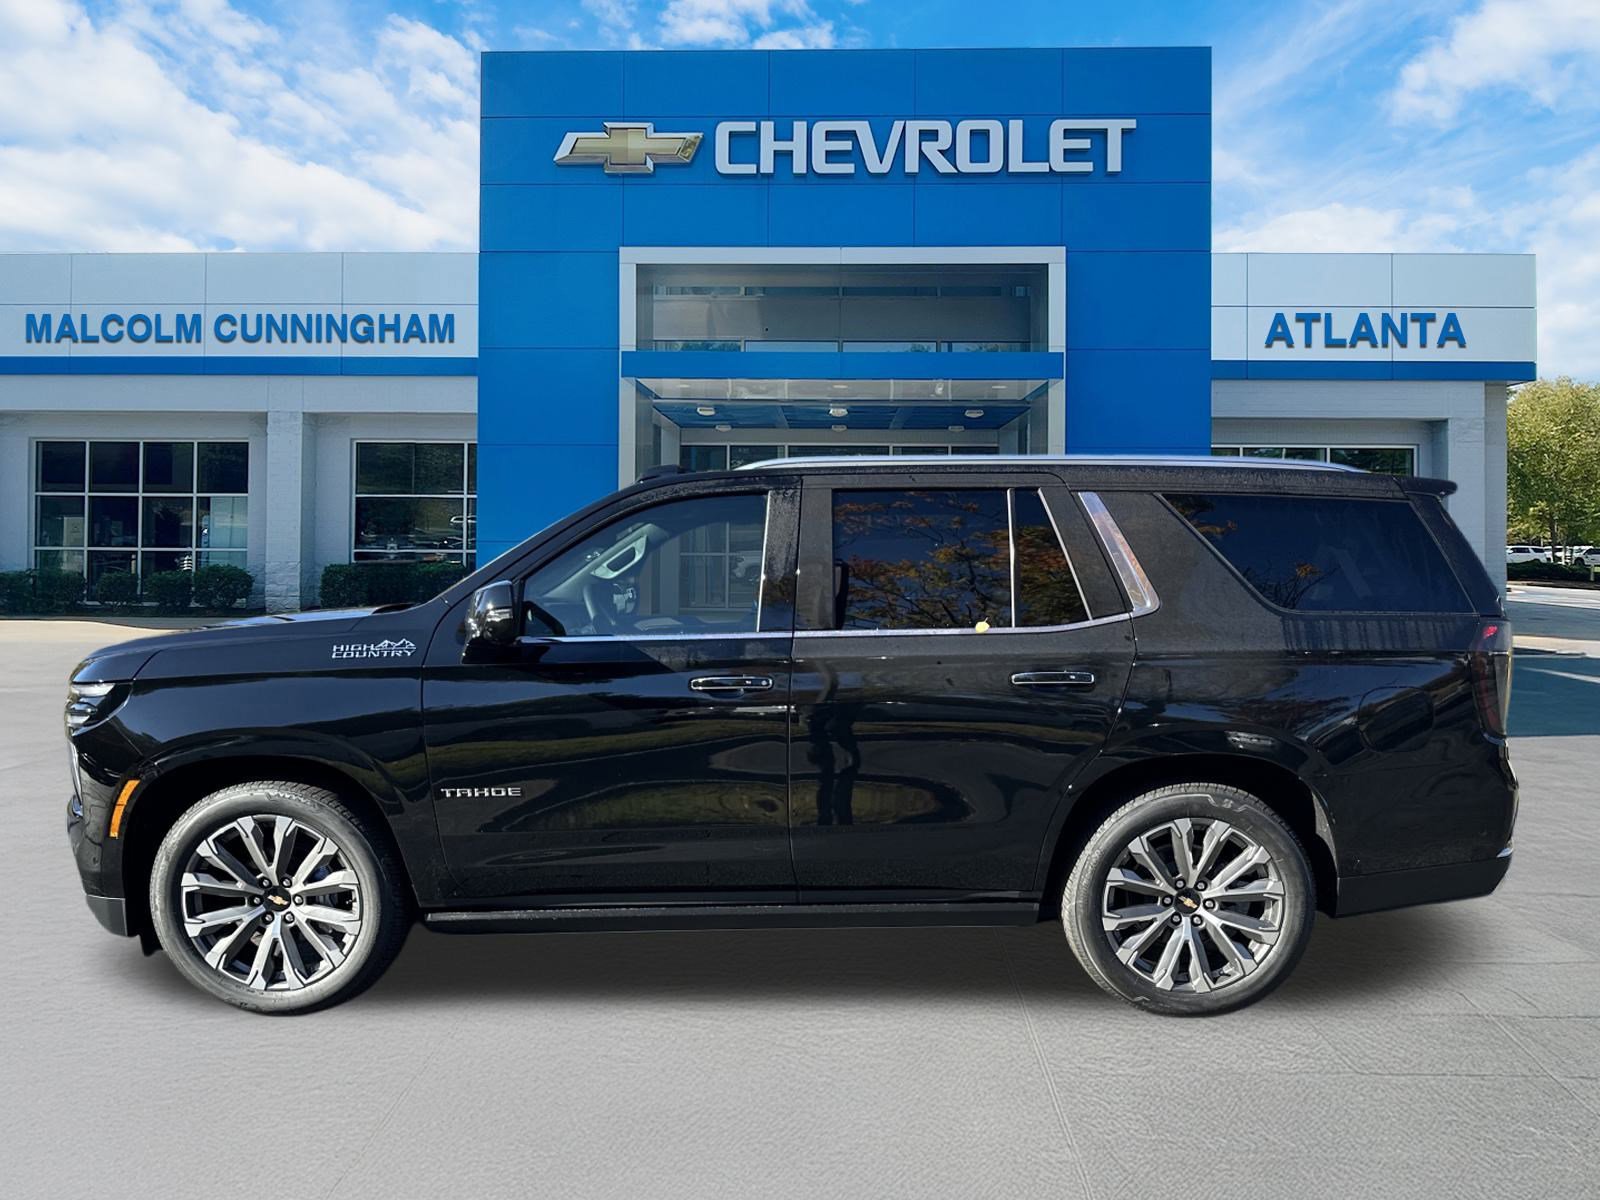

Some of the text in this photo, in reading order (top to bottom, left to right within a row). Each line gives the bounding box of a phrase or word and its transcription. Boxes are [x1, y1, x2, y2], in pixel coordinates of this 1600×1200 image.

[715, 118, 1137, 175] CHEVROLET
[25, 313, 455, 343] MALCOLM CUNNINGHAM
[1264, 312, 1467, 349] ATLANTA
[331, 650, 416, 659] COUNTRY
[332, 643, 375, 652] HIGH
[440, 787, 522, 798] TAHOE
